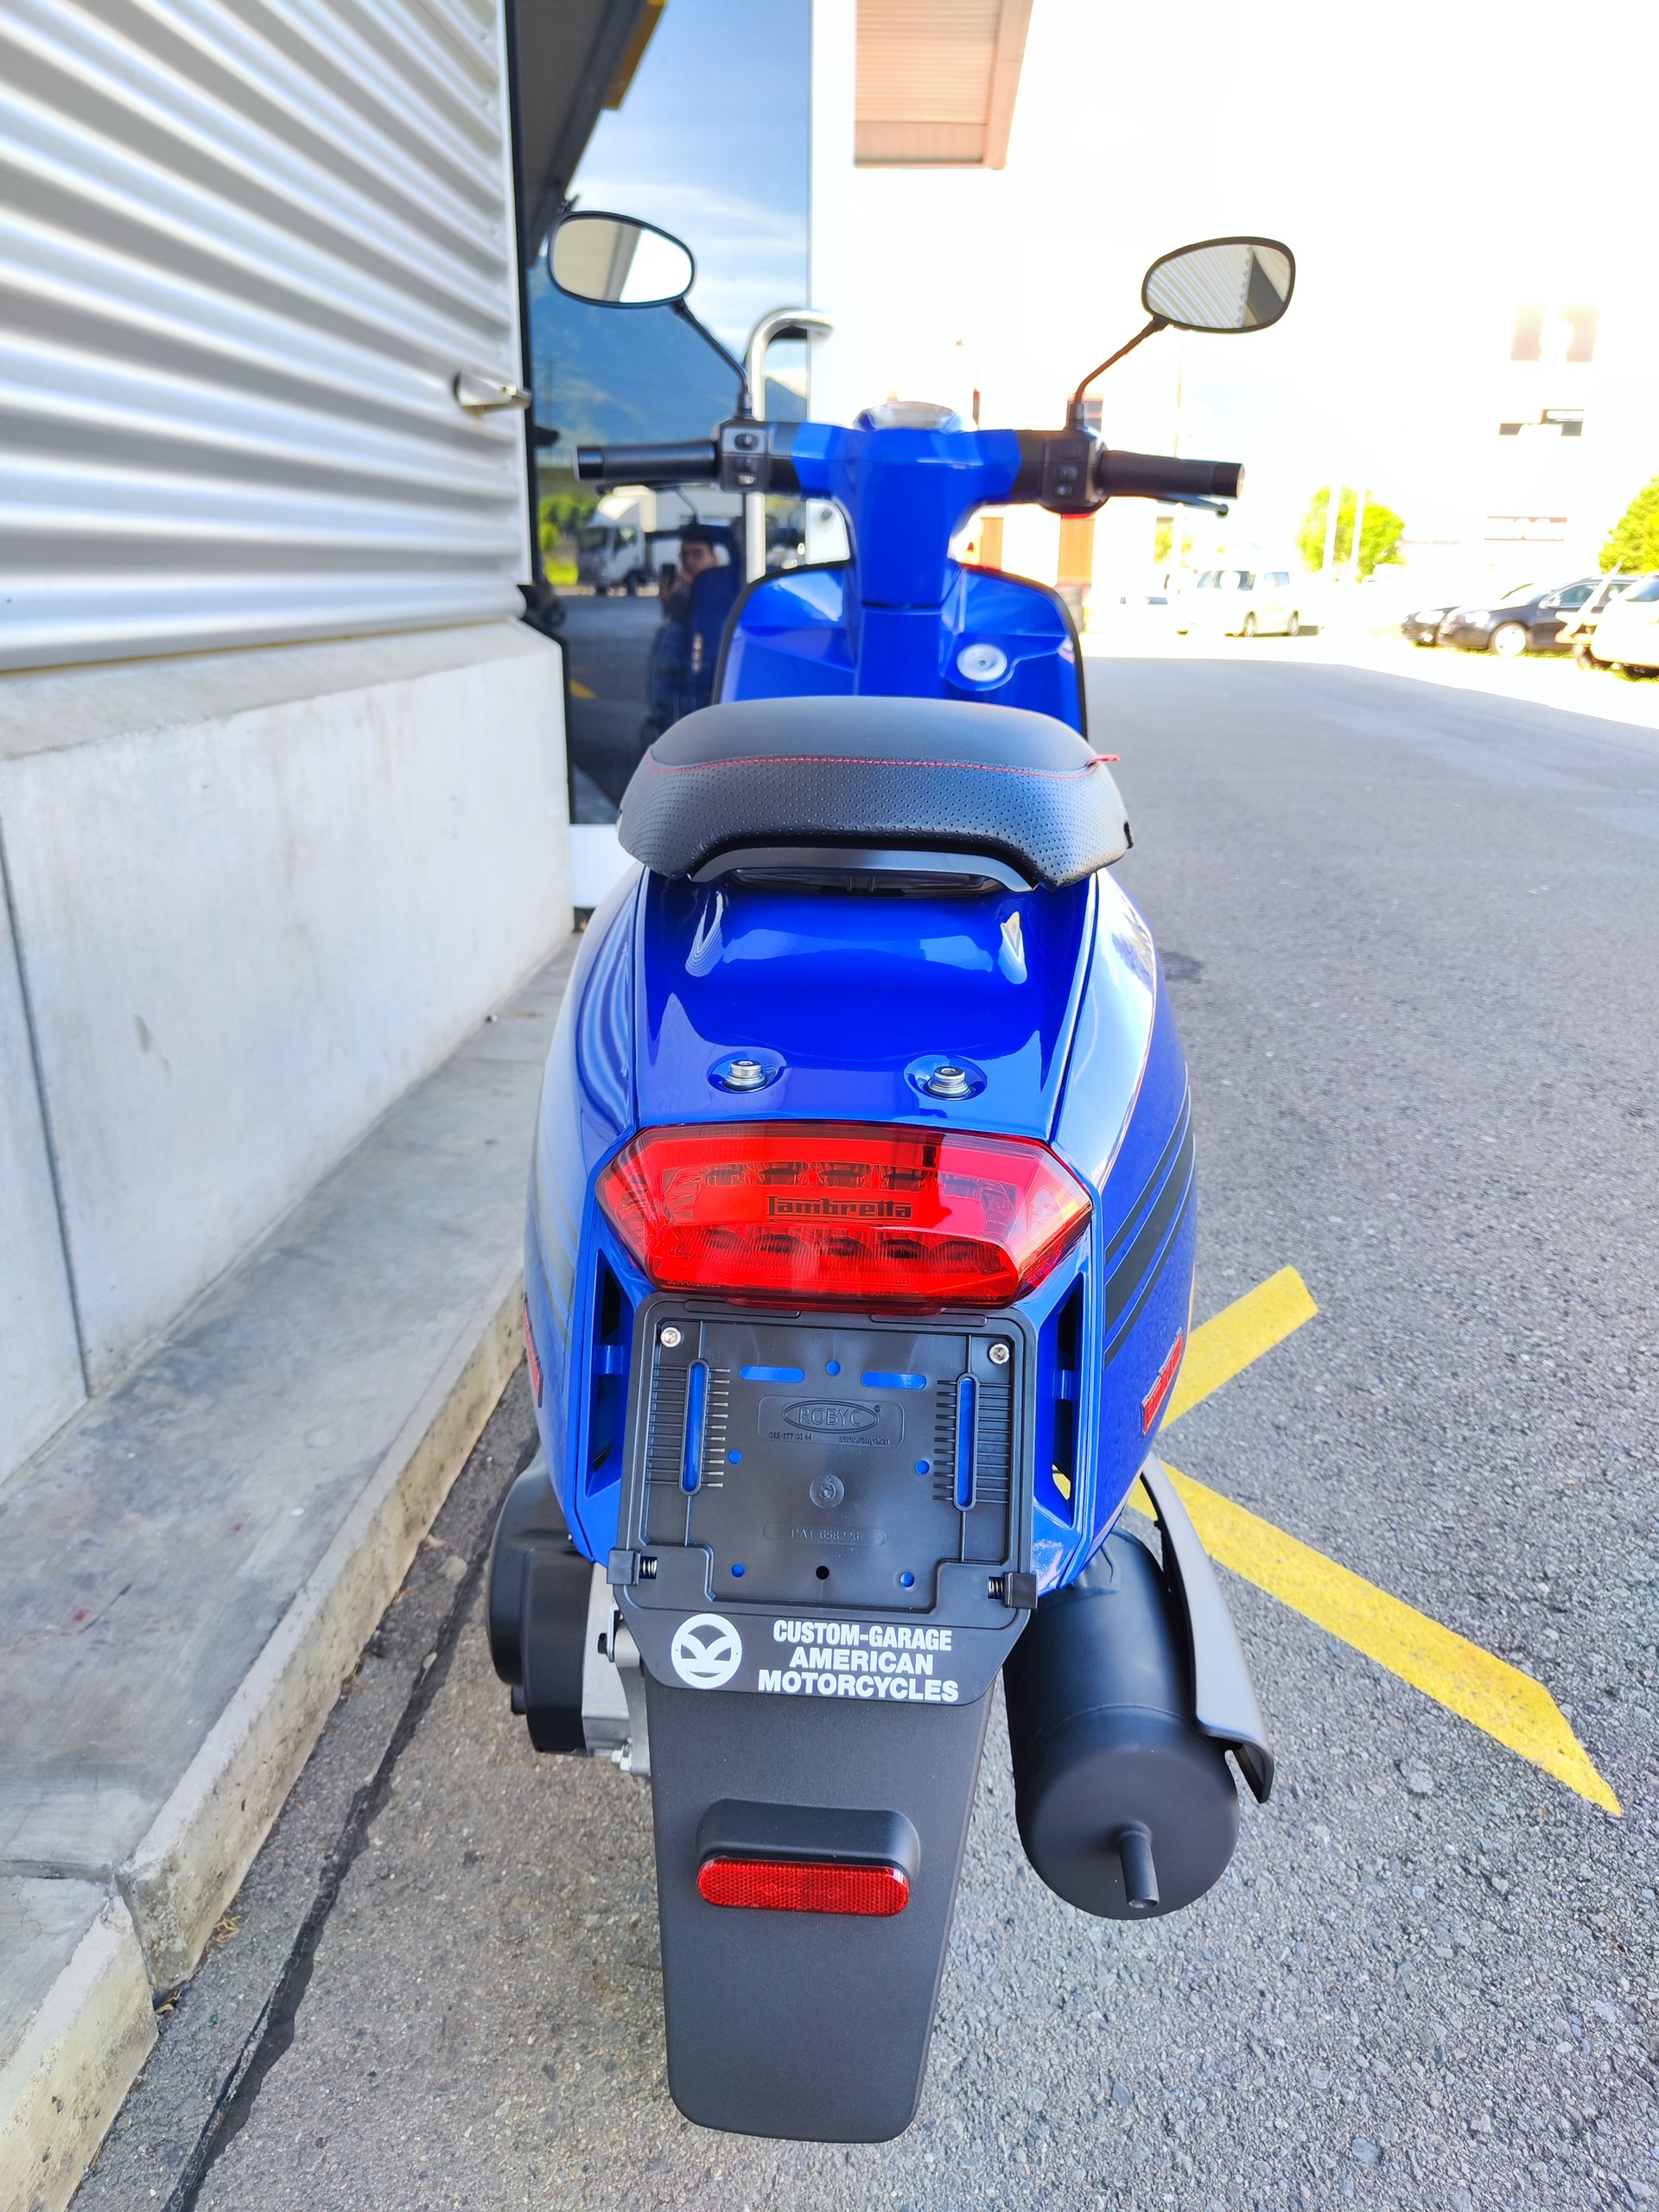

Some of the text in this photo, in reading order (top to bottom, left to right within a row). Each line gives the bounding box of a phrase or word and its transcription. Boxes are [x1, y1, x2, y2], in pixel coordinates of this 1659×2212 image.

[798, 1407, 862, 1427] ROBYC
[820, 1530, 860, 1541] 658226
[773, 1620, 952, 1651] CUSTOM-GARAGE
[789, 1646, 933, 1675] AMERICAN
[758, 1669, 959, 1702] MOTORCYCLES
